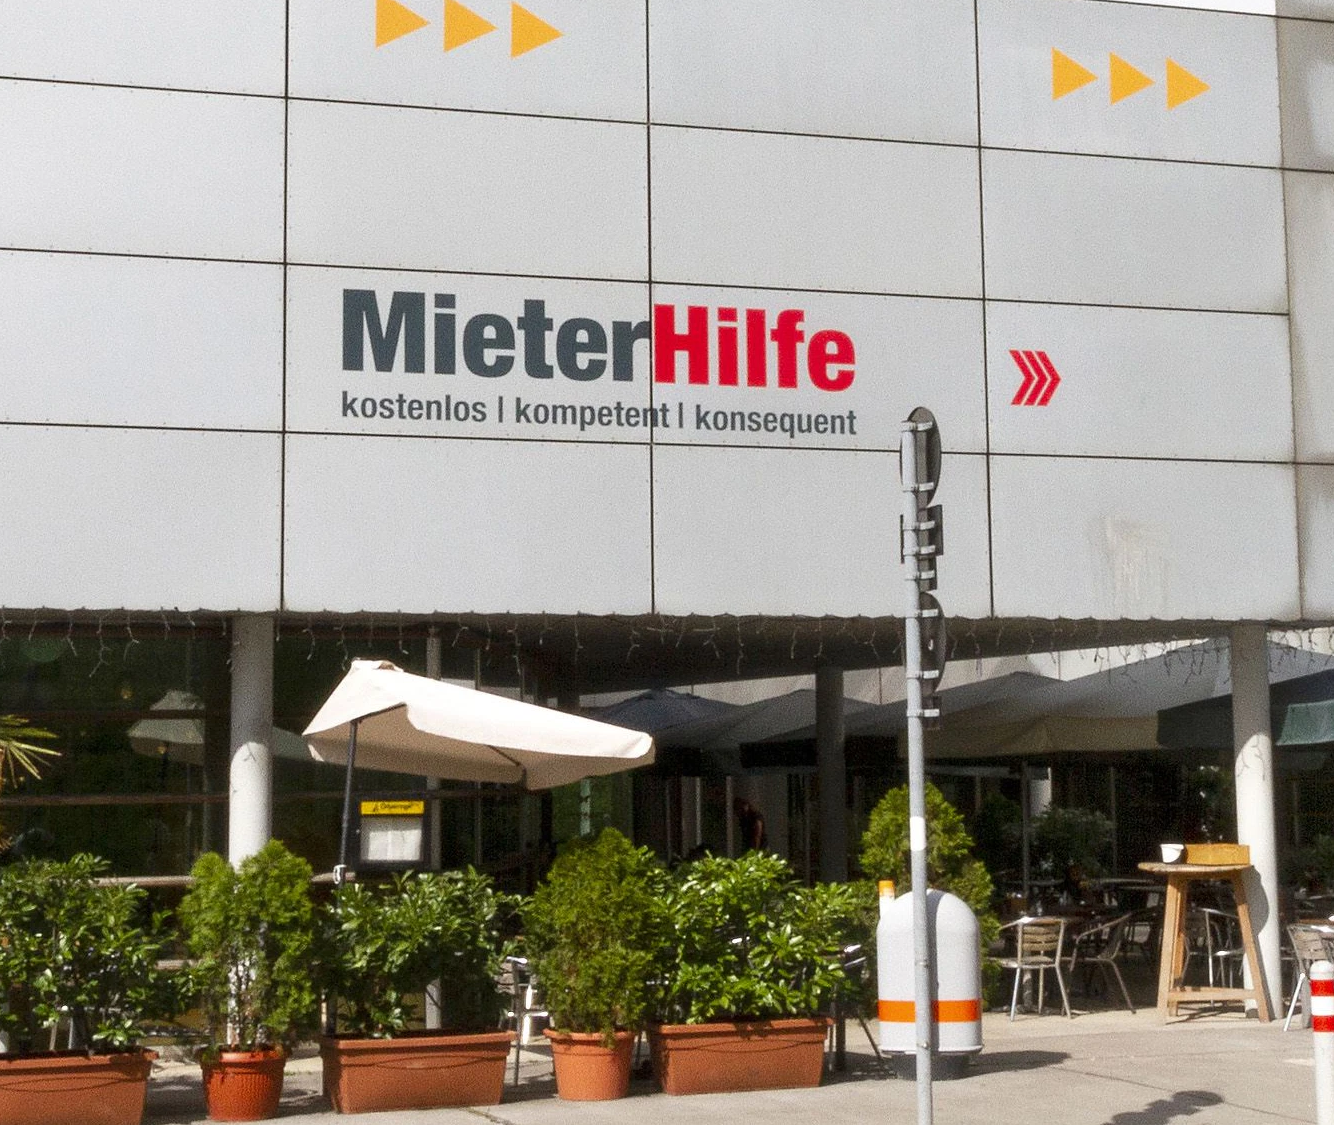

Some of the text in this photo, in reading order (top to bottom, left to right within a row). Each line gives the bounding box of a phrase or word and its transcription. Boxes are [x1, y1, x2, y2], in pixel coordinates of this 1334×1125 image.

[342, 288, 856, 393] MieterHilfe
[342, 391, 487, 423] kostenlos
[515, 396, 670, 432] kompetent
[695, 403, 857, 439] konsequent
